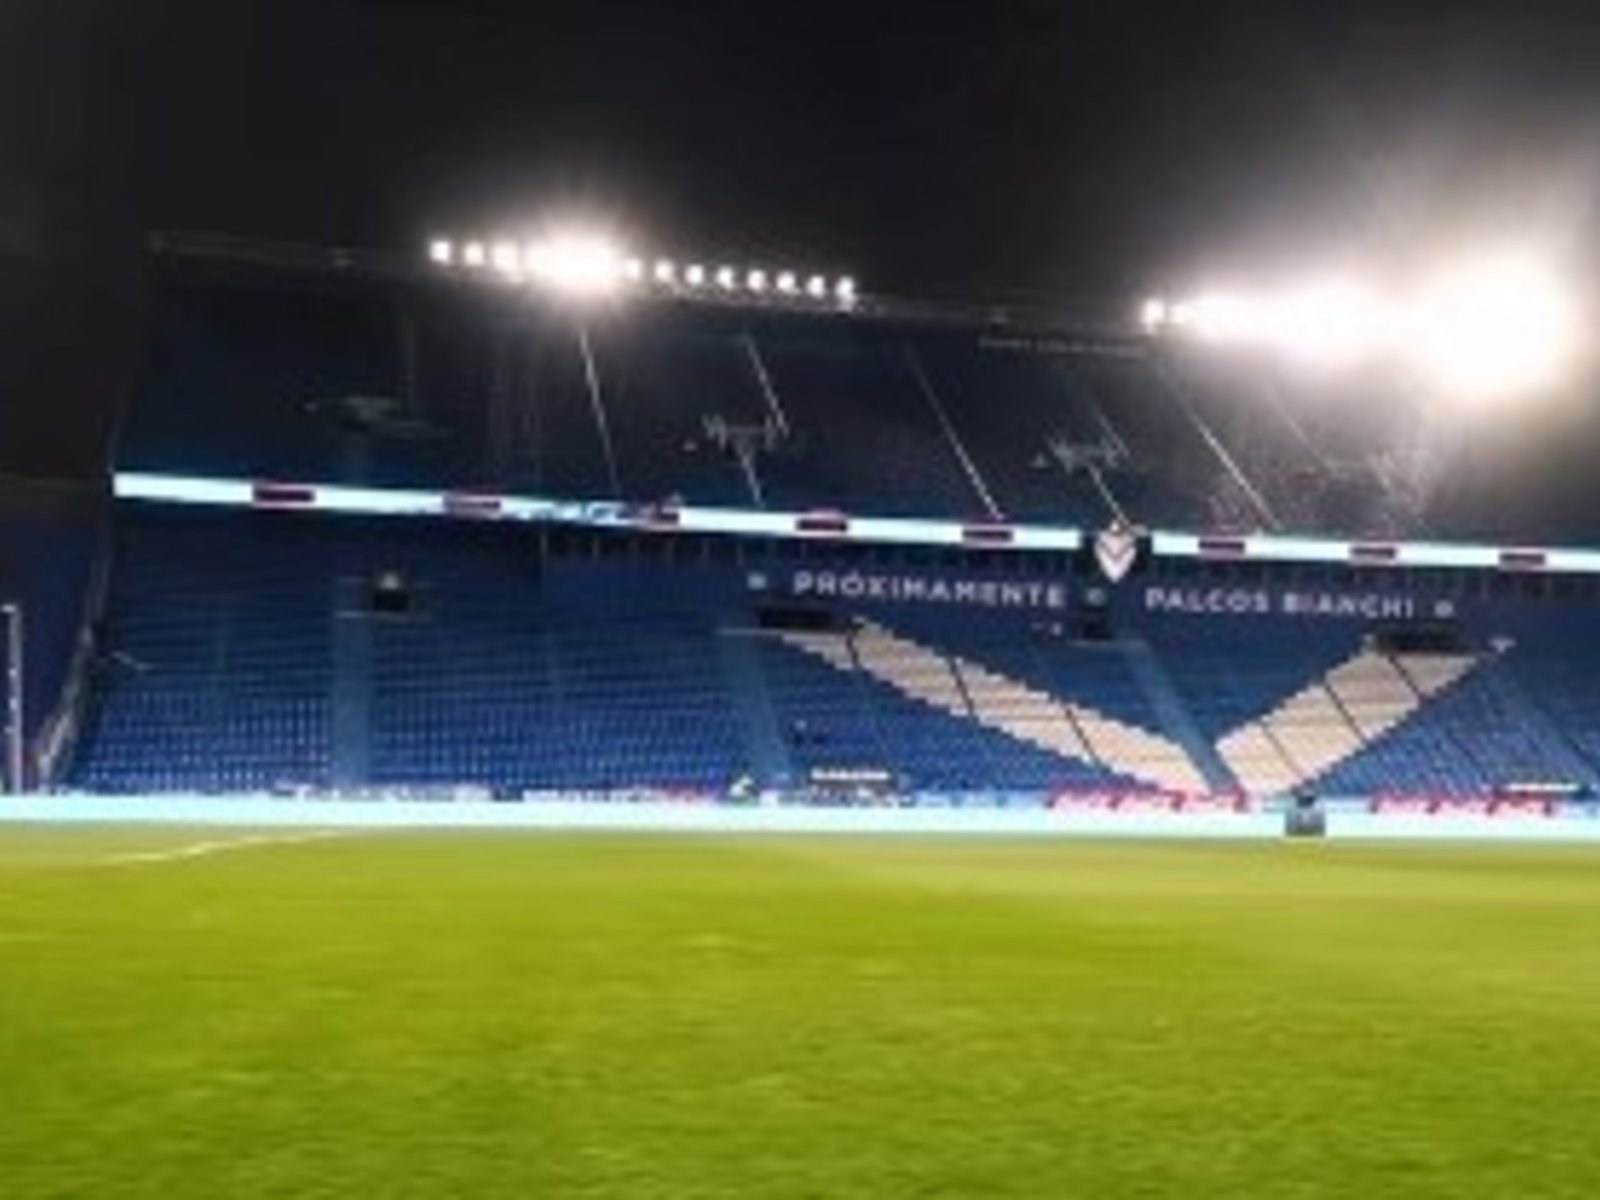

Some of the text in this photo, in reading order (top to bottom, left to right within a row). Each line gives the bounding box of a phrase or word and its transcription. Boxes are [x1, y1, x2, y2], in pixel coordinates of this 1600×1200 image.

[793, 570, 1415, 620] PRÓXIMAMENTE PALCOS BIANCHI
